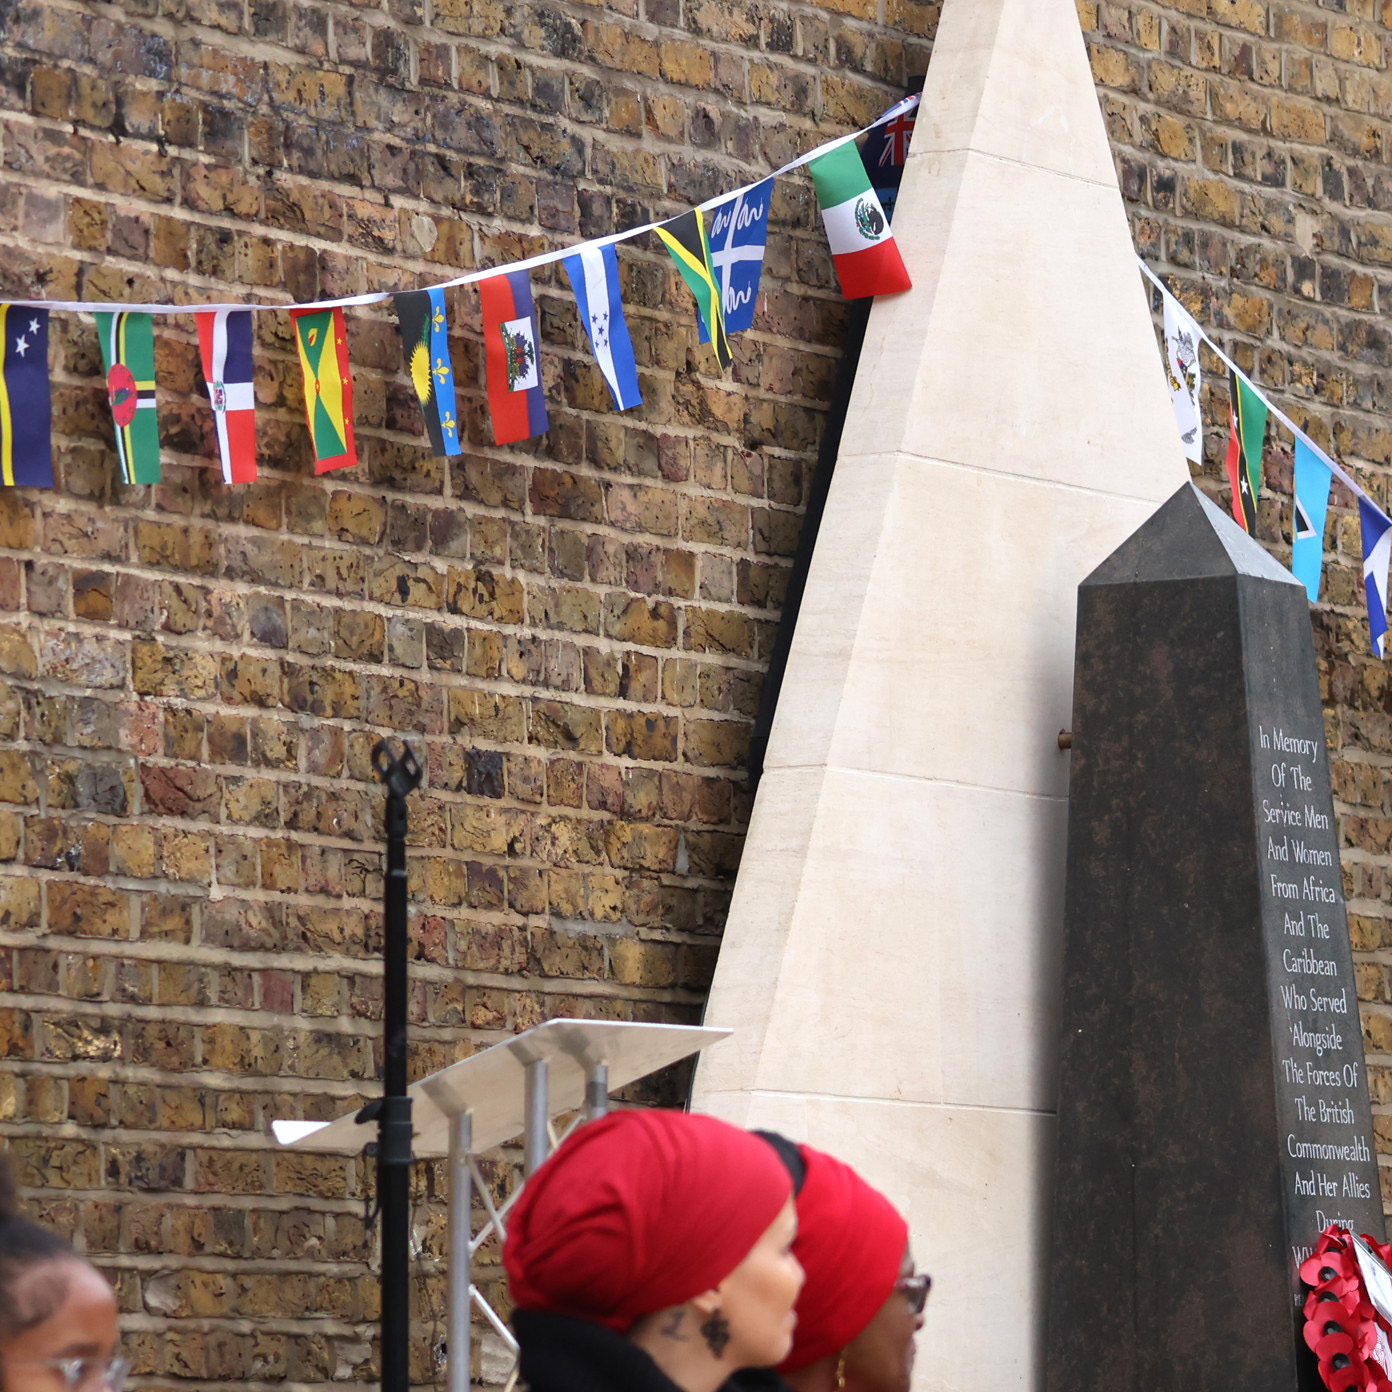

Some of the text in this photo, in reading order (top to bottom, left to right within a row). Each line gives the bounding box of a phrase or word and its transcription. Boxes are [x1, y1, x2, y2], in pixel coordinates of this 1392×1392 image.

[1258, 725, 1318, 763] In Memory
[1271, 762, 1312, 792] Of The
[1262, 799, 1329, 830] Service Men
[1267, 836, 1332, 867] And Women
[1270, 874, 1336, 904] From Africa
[1284, 911, 1330, 940] And The
[1283, 948, 1337, 977] Caribbean
[1280, 984, 1347, 1014] Who Served
[1292, 1023, 1343, 1057] Alongside
[1282, 1056, 1359, 1088] The Forces Of
[1294, 1095, 1355, 1125] The British
[1287, 1133, 1370, 1162] Commonwealth
[1294, 1169, 1371, 1199] And Her Allies
